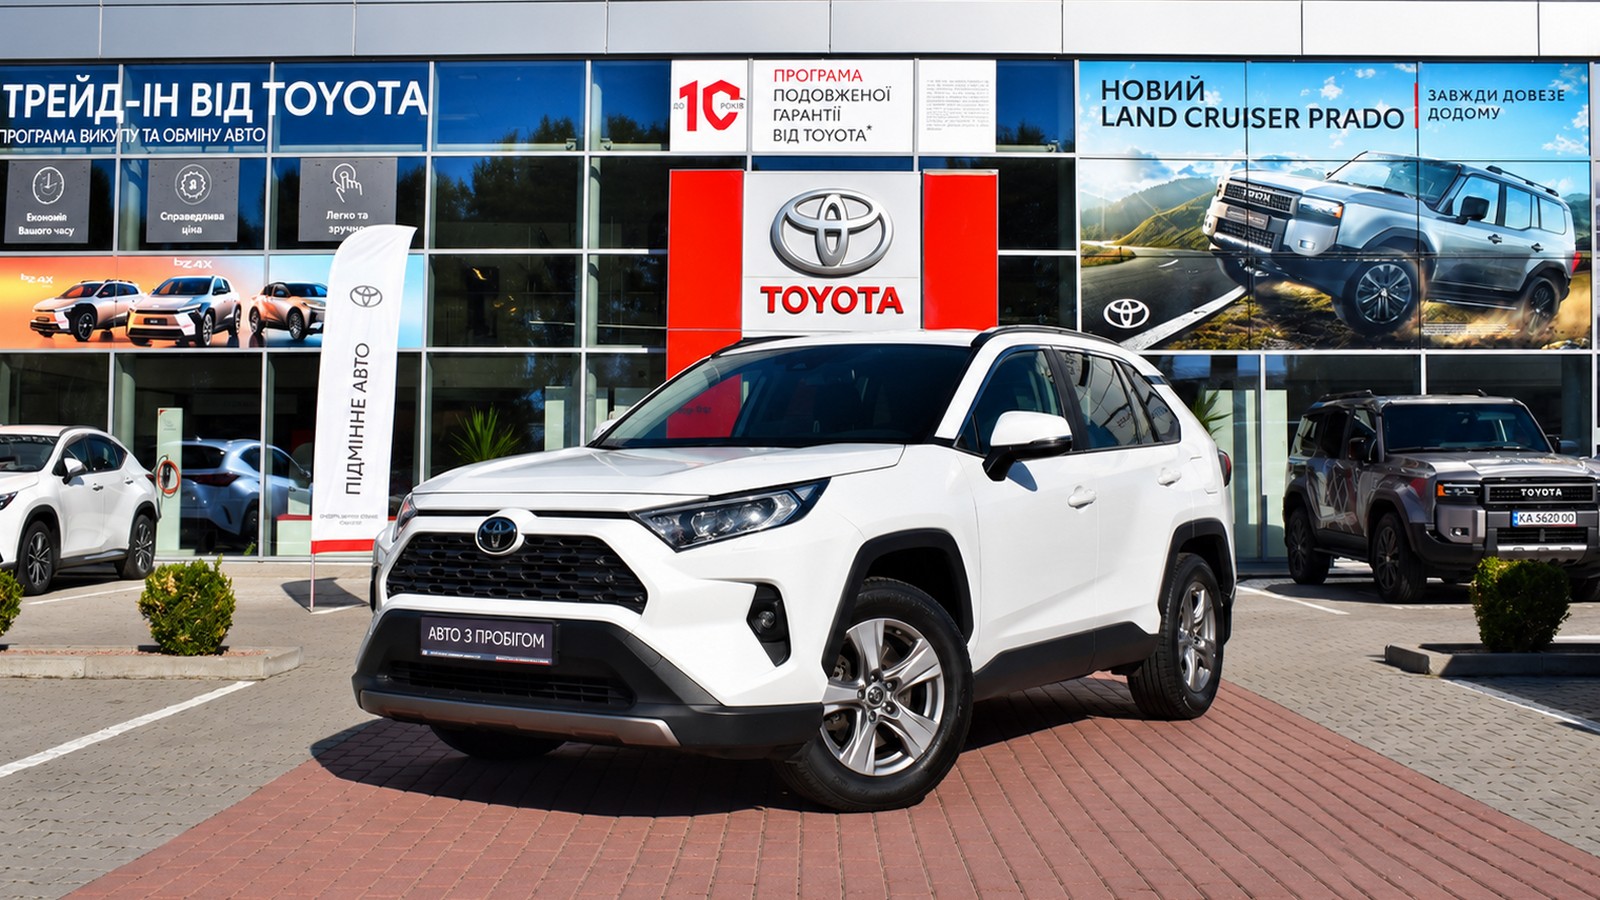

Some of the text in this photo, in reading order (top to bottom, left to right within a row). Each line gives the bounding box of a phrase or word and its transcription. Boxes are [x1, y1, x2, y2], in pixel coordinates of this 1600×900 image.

[774, 69, 863, 82] ПРОГРАМА
[773, 86, 892, 104] ПОДОВЖЕНОЇ
[1101, 75, 1205, 101] НОВИЙ
[1428, 89, 1565, 103] ЗАВЖДИ ДОВЕЗЕ
[3, 75, 428, 125] ТРЕЙД-ІН ВІД TOYOTA
[1101, 106, 1405, 130] LAND CRUISER PRADO
[1428, 107, 1501, 121] ДОДОМУ
[80, 128, 140, 143] ВИКУПУ
[143, 128, 161, 142] ТА
[163, 127, 222, 142] ОБМІНУ
[224, 127, 266, 142] АВТО
[773, 128, 799, 144] ВІД
[160, 211, 225, 223] Справедлива
[326, 211, 369, 220] Легко та
[18, 226, 75, 237] Вашого часу
[760, 285, 905, 315] TOYOTA
[345, 342, 370, 495] ПІДМІННЕ АВТО
[1520, 488, 1563, 497] TOYOTA
[1519, 513, 1534, 523] KA
[1535, 513, 1560, 523] 5620
[428, 626, 461, 642] АВТО
[475, 629, 545, 649] ПРОБІГОМ
